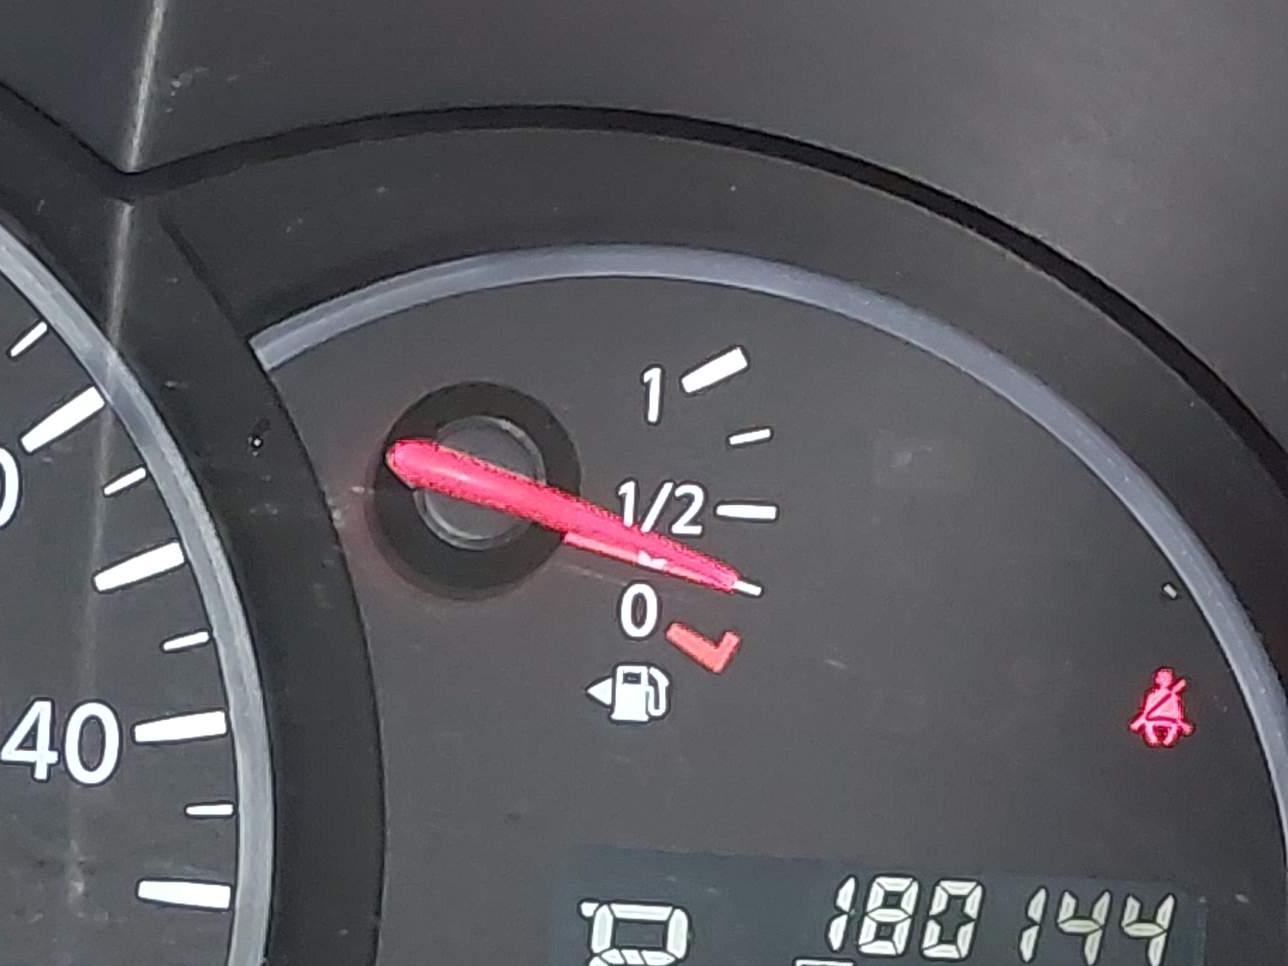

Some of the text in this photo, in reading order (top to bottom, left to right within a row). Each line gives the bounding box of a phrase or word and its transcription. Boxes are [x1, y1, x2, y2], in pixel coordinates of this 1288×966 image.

[642, 367, 662, 422] 1
[618, 480, 704, 534] 1/2
[620, 584, 658, 638] 0
